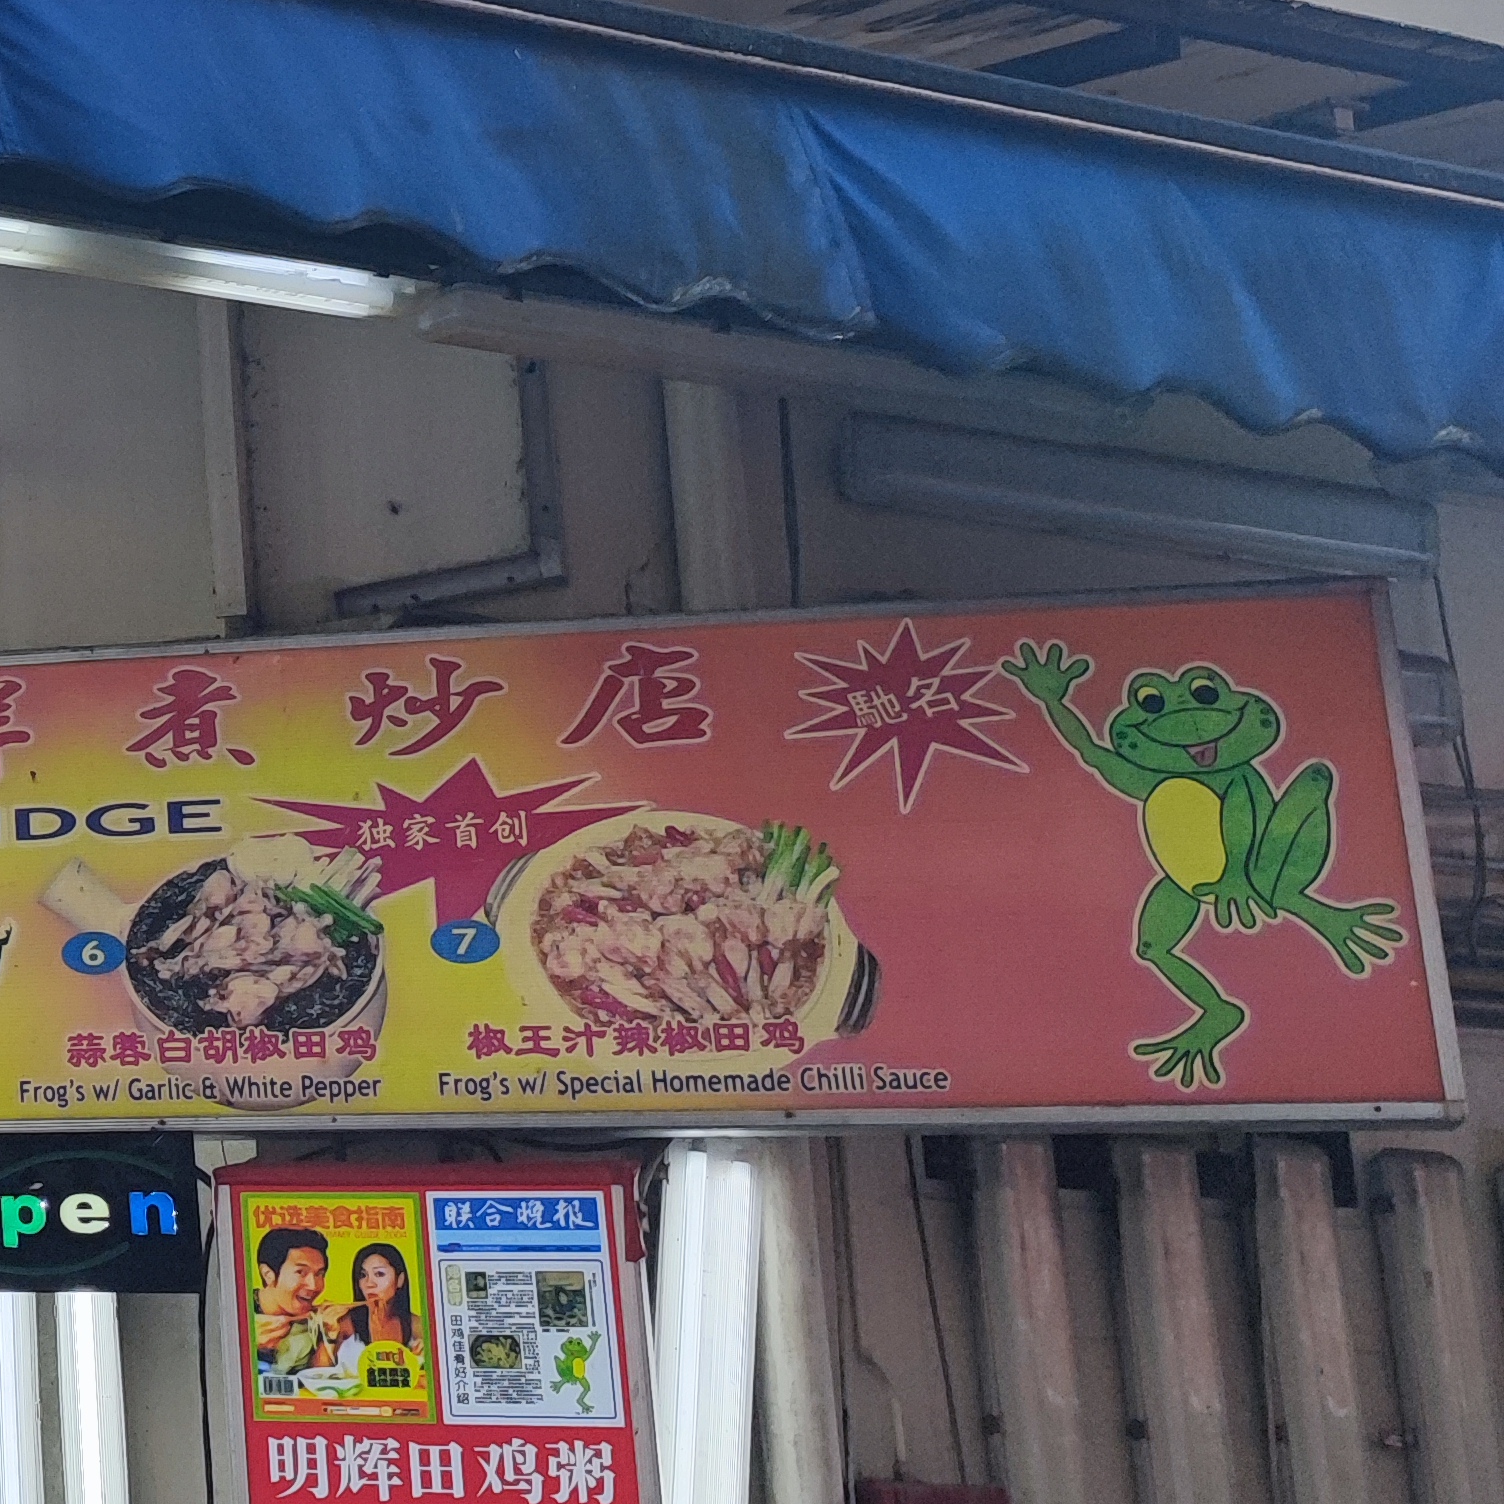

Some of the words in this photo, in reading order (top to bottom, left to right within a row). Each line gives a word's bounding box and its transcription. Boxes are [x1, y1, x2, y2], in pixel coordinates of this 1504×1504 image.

[354, 808, 530, 852] 独家首创
[81, 941, 105, 966] 6
[450, 928, 477, 955] 7
[66, 1026, 379, 1068] 蒜蓉白胡椒田鸡
[466, 1019, 806, 1060] 椒王汁辣椒田鸡
[18, 1079, 87, 1108] Frog's
[92, 1078, 120, 1102] w/
[127, 1077, 193, 1101] Garlic
[201, 1078, 218, 1100] &
[225, 1075, 293, 1100] White
[301, 1074, 382, 1104] Pepper
[437, 1071, 510, 1102] Frog's
[518, 1071, 547, 1095] w/
[556, 1068, 643, 1099] Special
[652, 1067, 791, 1094] Homemade
[799, 1065, 865, 1091] Chilli
[874, 1065, 949, 1092] Sauce
[253, 1205, 406, 1231] 优选美食指南
